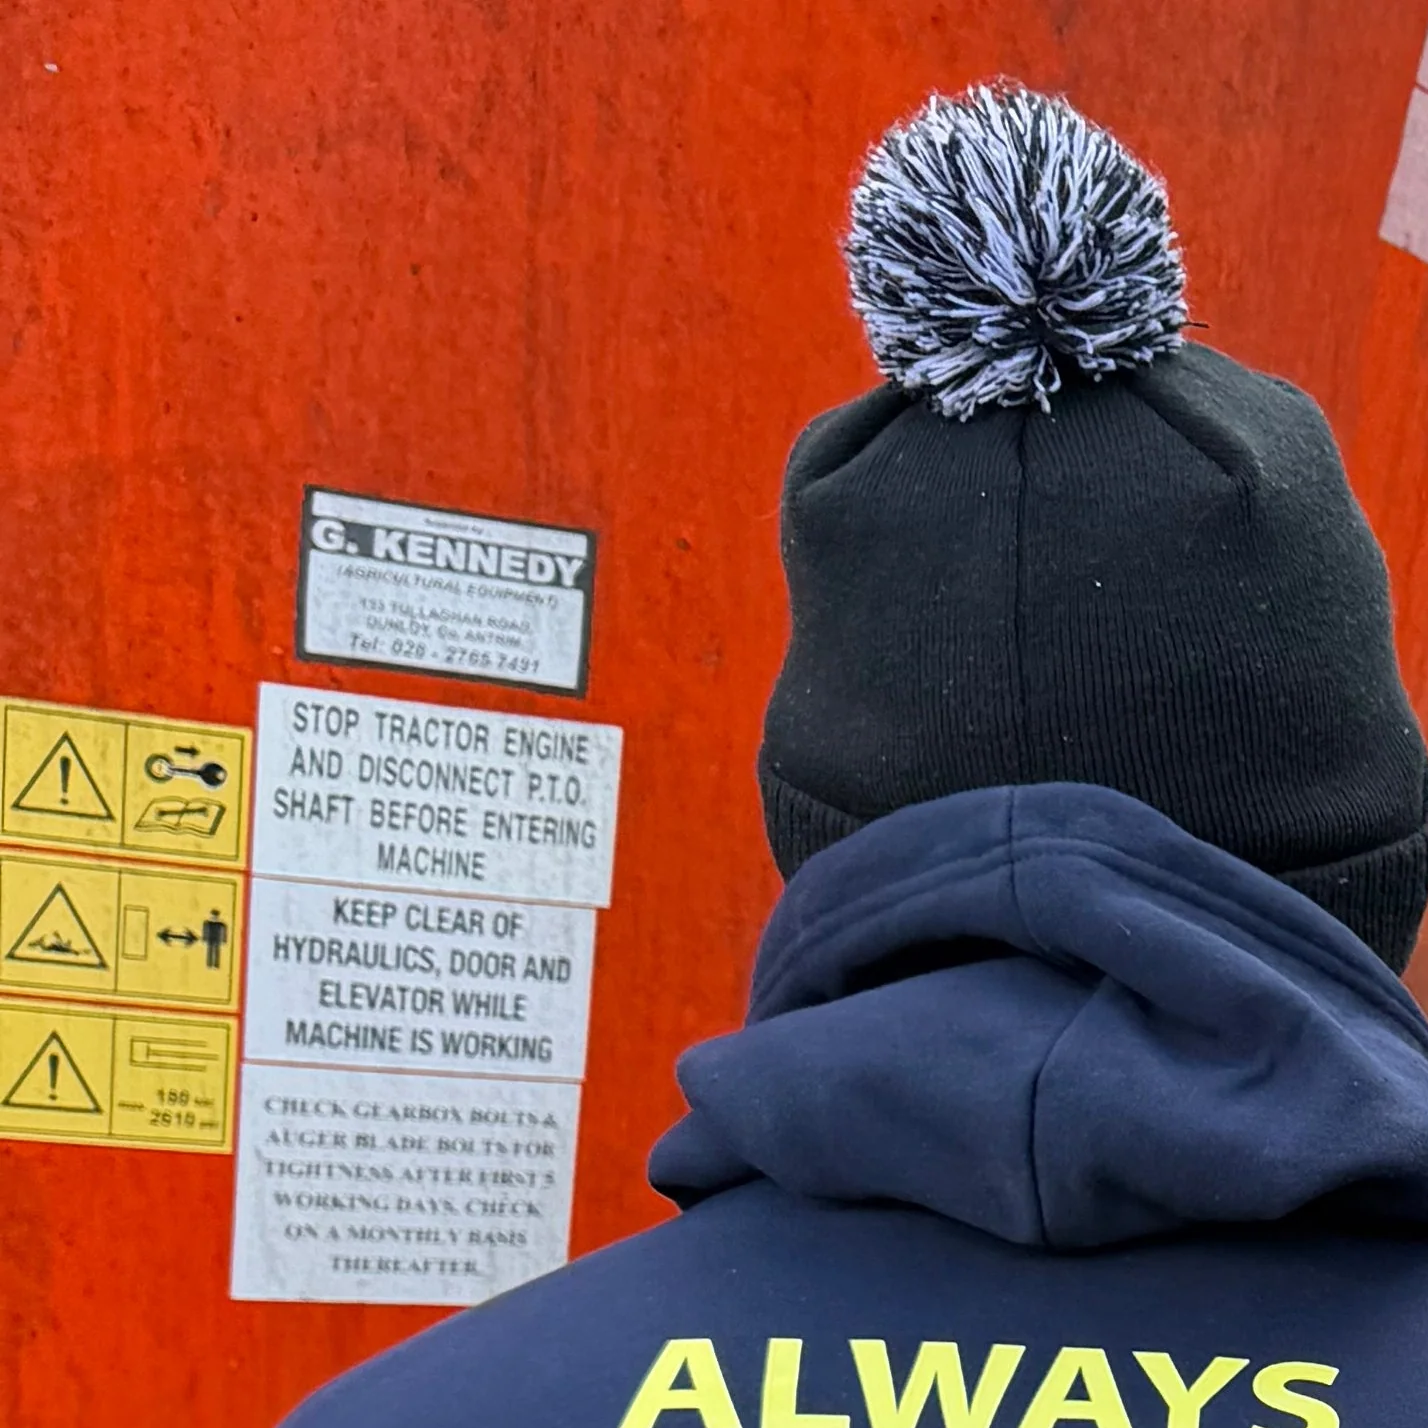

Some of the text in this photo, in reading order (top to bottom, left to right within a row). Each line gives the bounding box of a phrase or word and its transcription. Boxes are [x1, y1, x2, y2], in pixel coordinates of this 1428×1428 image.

[311, 519, 584, 587] G. KENNEDY
[293, 702, 589, 764] STOP TRACTOR ENGINE
[290, 747, 587, 806] AND DISCONNECT P.T.O.
[272, 788, 596, 849] SHAFT BEFORE ENTERING
[376, 843, 487, 881] MACHINE
[332, 897, 524, 940] KEEP CLEAR OF
[272, 933, 571, 984] HYDRAULICS, DOOR AND
[319, 979, 527, 1021] ELEVATOR WHILE
[285, 1020, 553, 1063] MACHINE IS WORKING
[264, 1096, 348, 1116] CHECK
[353, 1102, 464, 1124] GEARBOX
[469, 1107, 539, 1126] BOLTS
[266, 1129, 556, 1158] AUGER BLADE BOLTS FOR
[264, 1159, 394, 1182] TIGHTNESS
[402, 1166, 473, 1184] AFTER
[478, 1169, 538, 1189] FIRST
[273, 1191, 390, 1212] WORKING
[465, 1199, 543, 1219] CHECK
[284, 1223, 318, 1240] ON
[326, 1224, 343, 1241] A
[347, 1225, 460, 1245] MONTHLY
